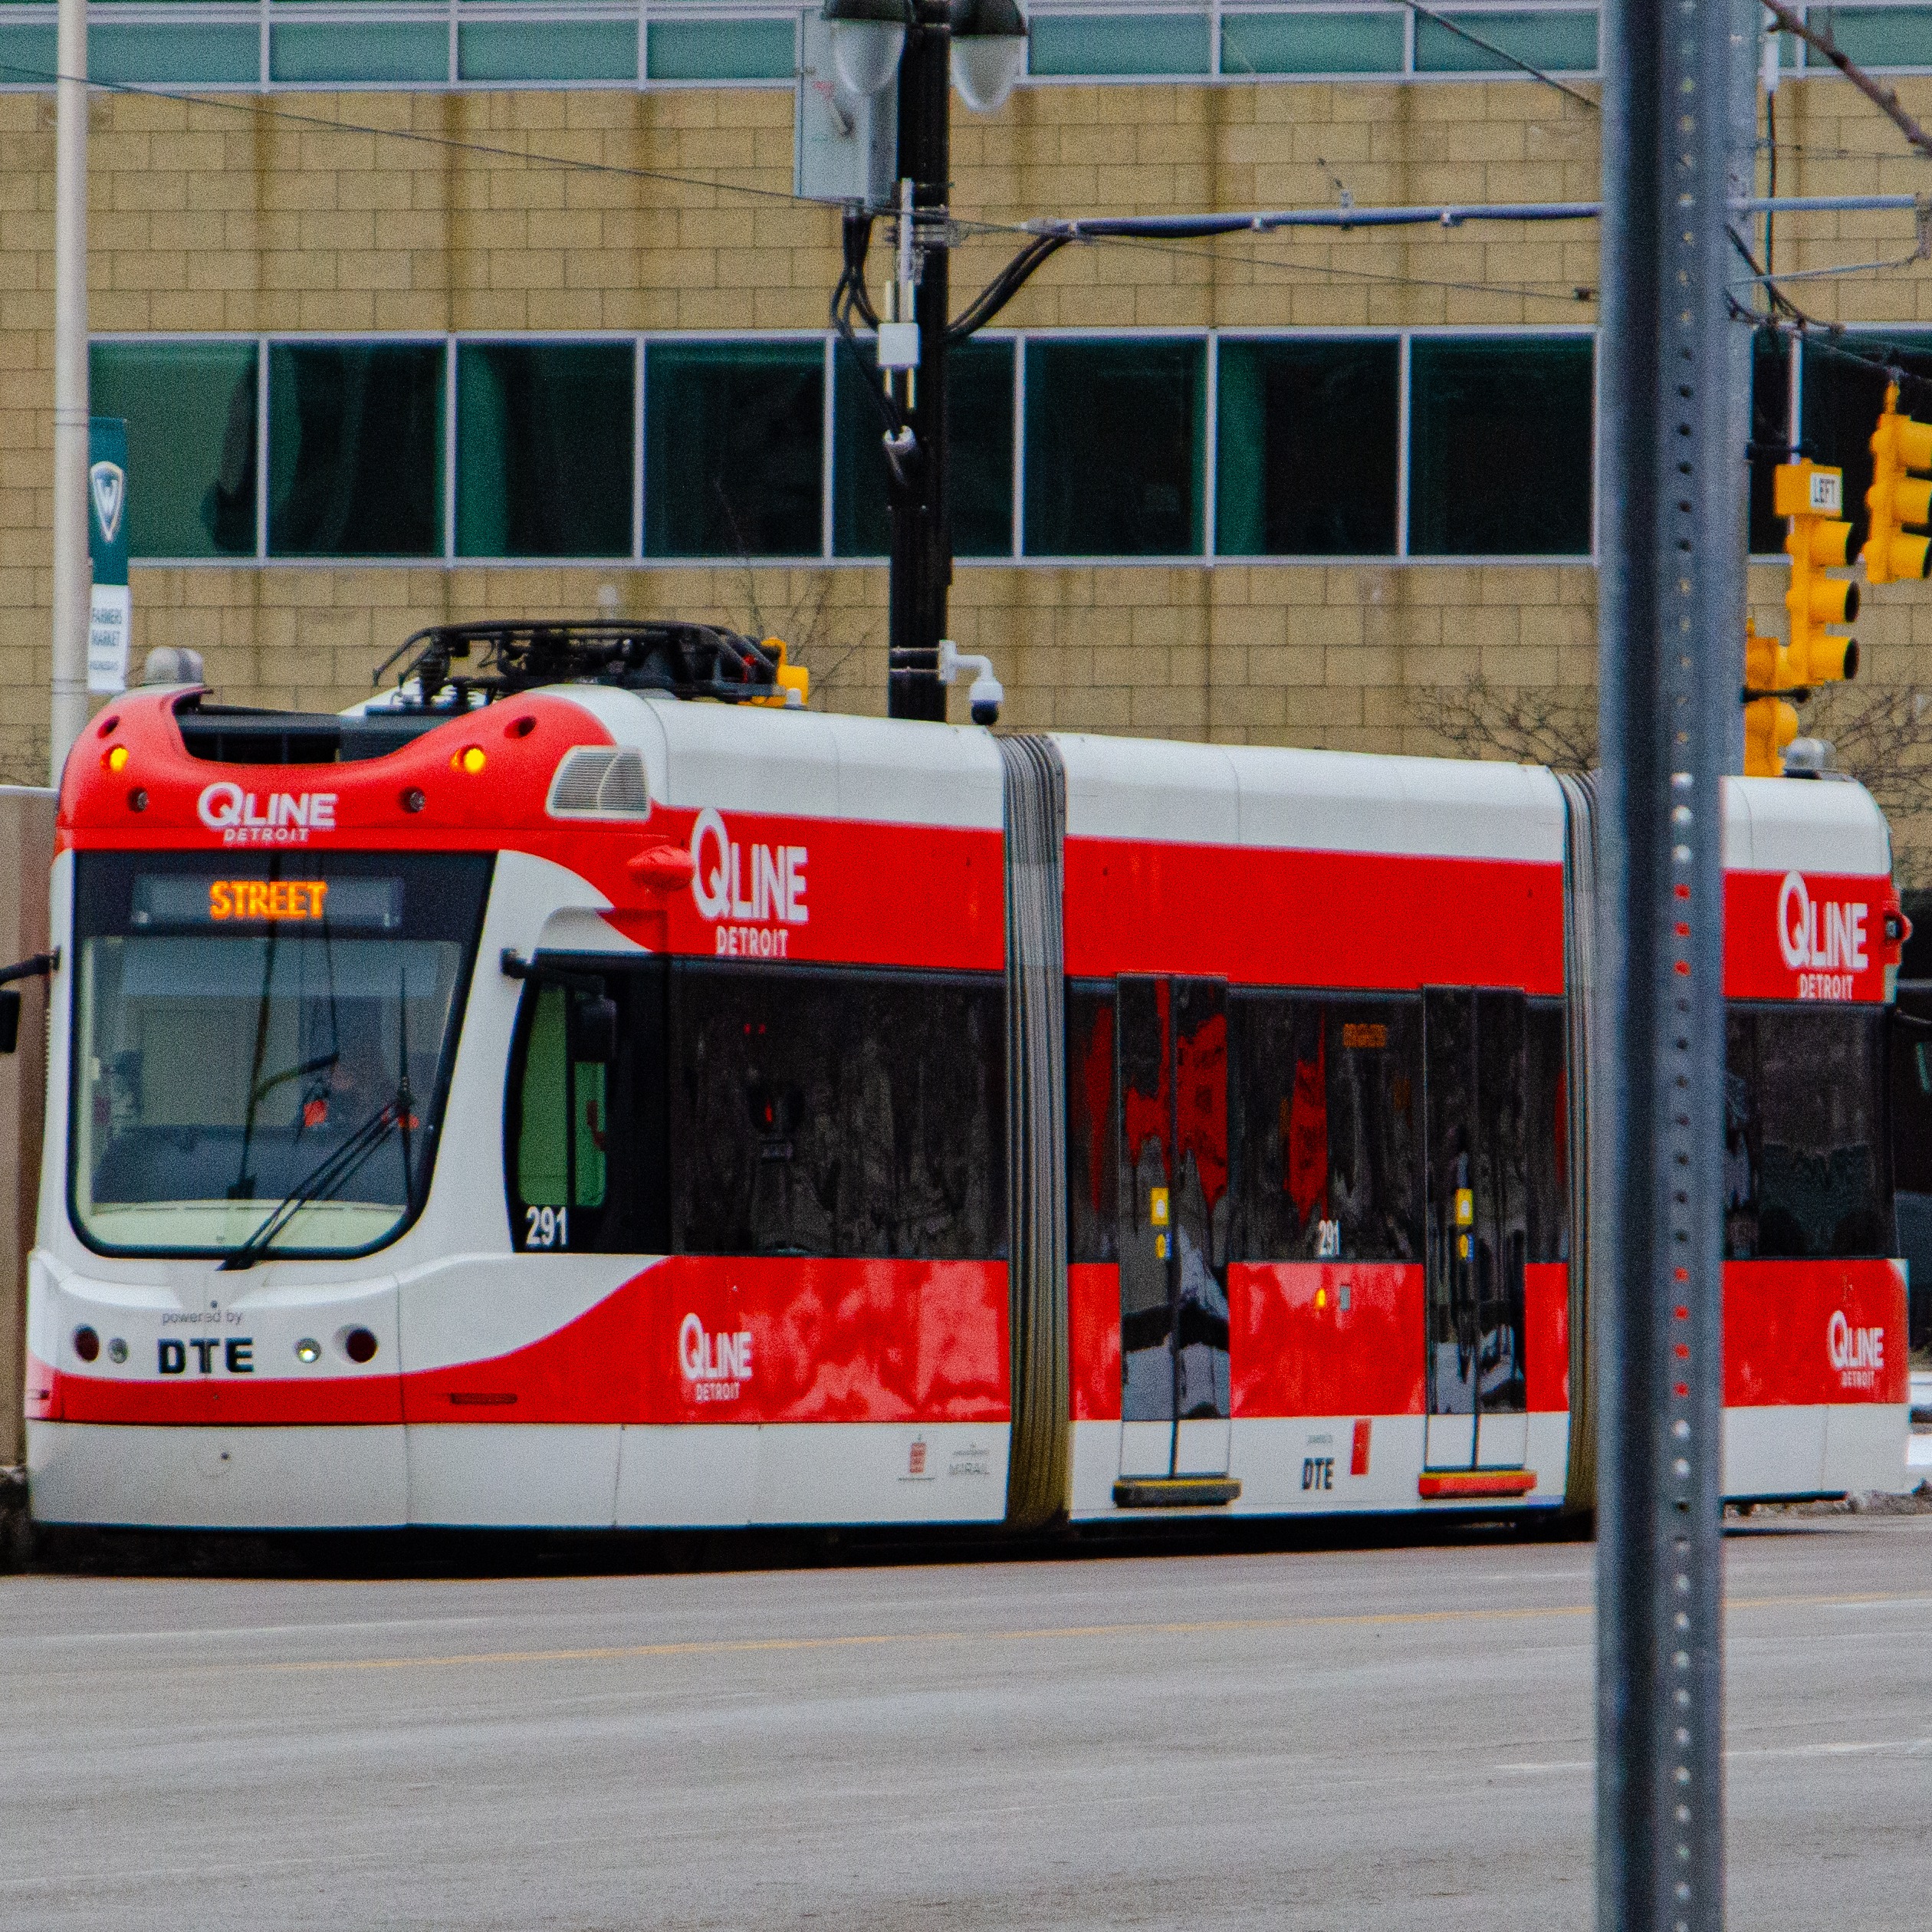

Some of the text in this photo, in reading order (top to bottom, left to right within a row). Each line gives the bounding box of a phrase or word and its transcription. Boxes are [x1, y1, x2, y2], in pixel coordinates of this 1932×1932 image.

[1813, 478, 1835, 503] LEFT
[197, 781, 337, 829] QLINE
[224, 828, 309, 845] DETROIT
[690, 807, 809, 925] QLINE
[209, 880, 329, 920] STREET
[1777, 869, 1869, 973] QLINE
[715, 924, 788, 958] DETROIT
[1799, 973, 1854, 1000] DETROIT
[525, 1206, 568, 1247] 291
[1318, 1219, 1340, 1257] 291
[162, 1309, 243, 1326] powered by
[157, 1337, 254, 1375] DTE
[678, 1313, 752, 1381] QLINE
[1827, 1309, 1884, 1371] QLINE
[695, 1382, 740, 1403] DETROIT
[1842, 1370, 1875, 1388] DETROIT
[1302, 1457, 1334, 1490] DTE
